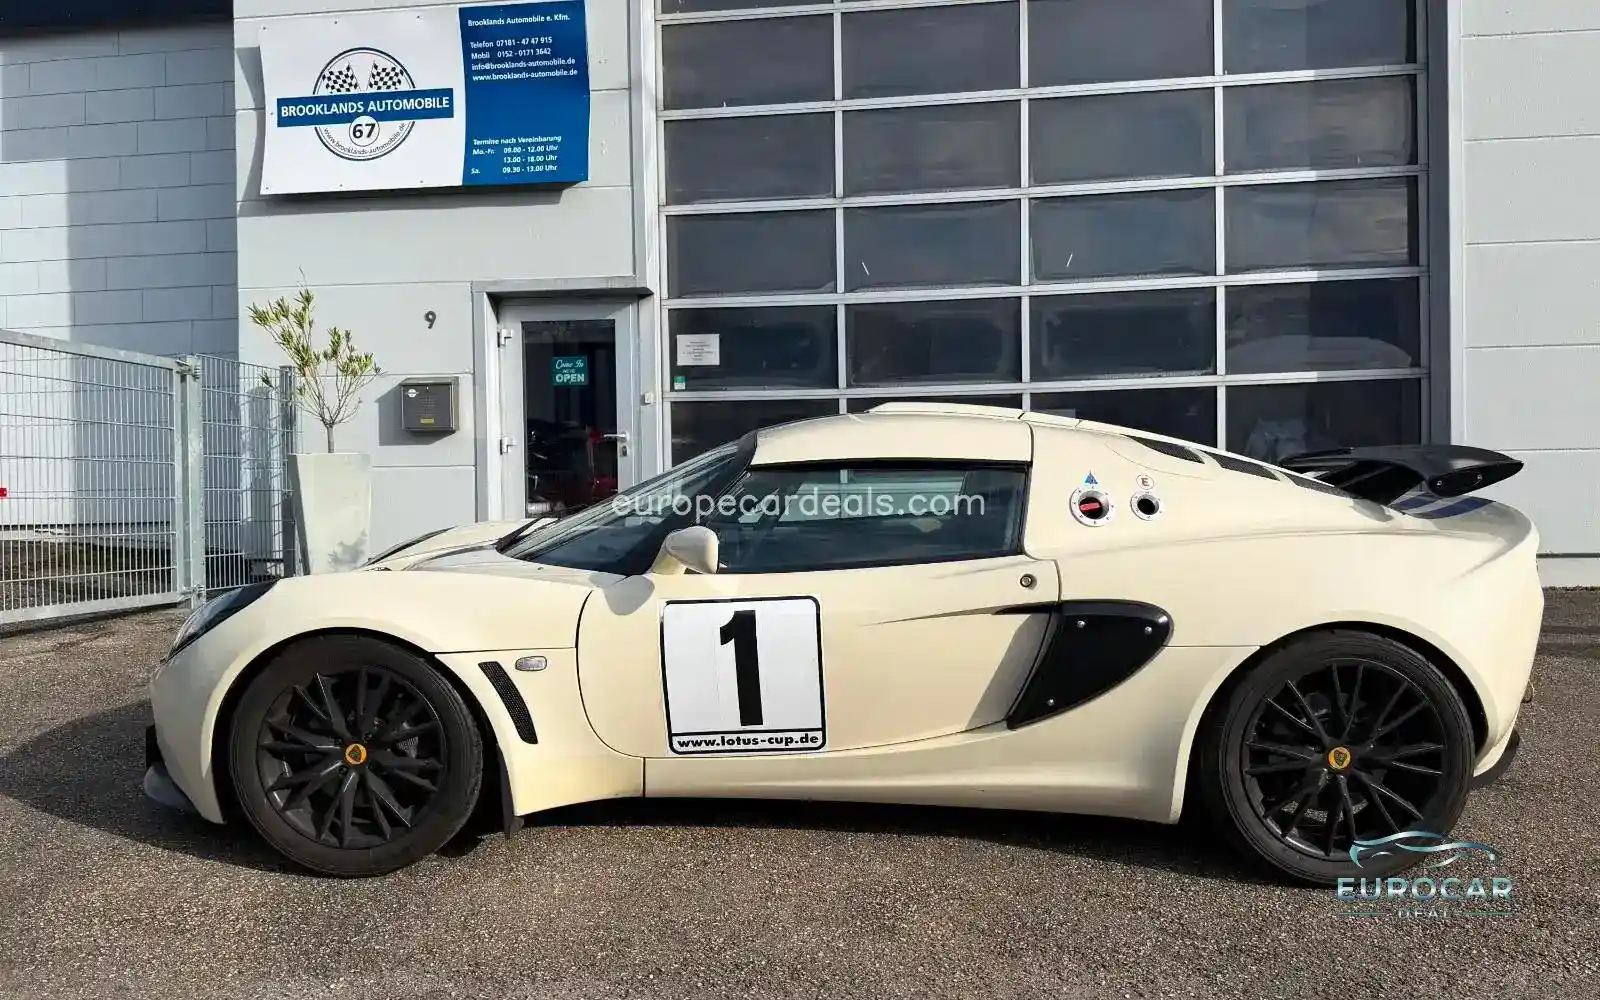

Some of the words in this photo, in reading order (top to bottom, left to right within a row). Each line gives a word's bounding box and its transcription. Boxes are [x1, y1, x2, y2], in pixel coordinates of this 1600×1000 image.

[468, 18, 504, 26] Brooklands
[506, 15, 544, 24] Automobile
[470, 40, 494, 48] Telefon
[471, 52, 490, 60] Mobil
[472, 57, 576, 71] info@brooklands-automobile.de
[472, 68, 578, 81] www.brooklands-automobile.de
[281, 101, 364, 117] BROOKLANDS
[368, 96, 450, 112] AUTOMOBILE
[352, 123, 376, 138] 67
[424, 310, 436, 329] 9
[556, 374, 584, 382] OPEN
[1141, 478, 1149, 486] E
[720, 610, 764, 726] 1
[677, 734, 818, 748] www.lotus-cup.de
